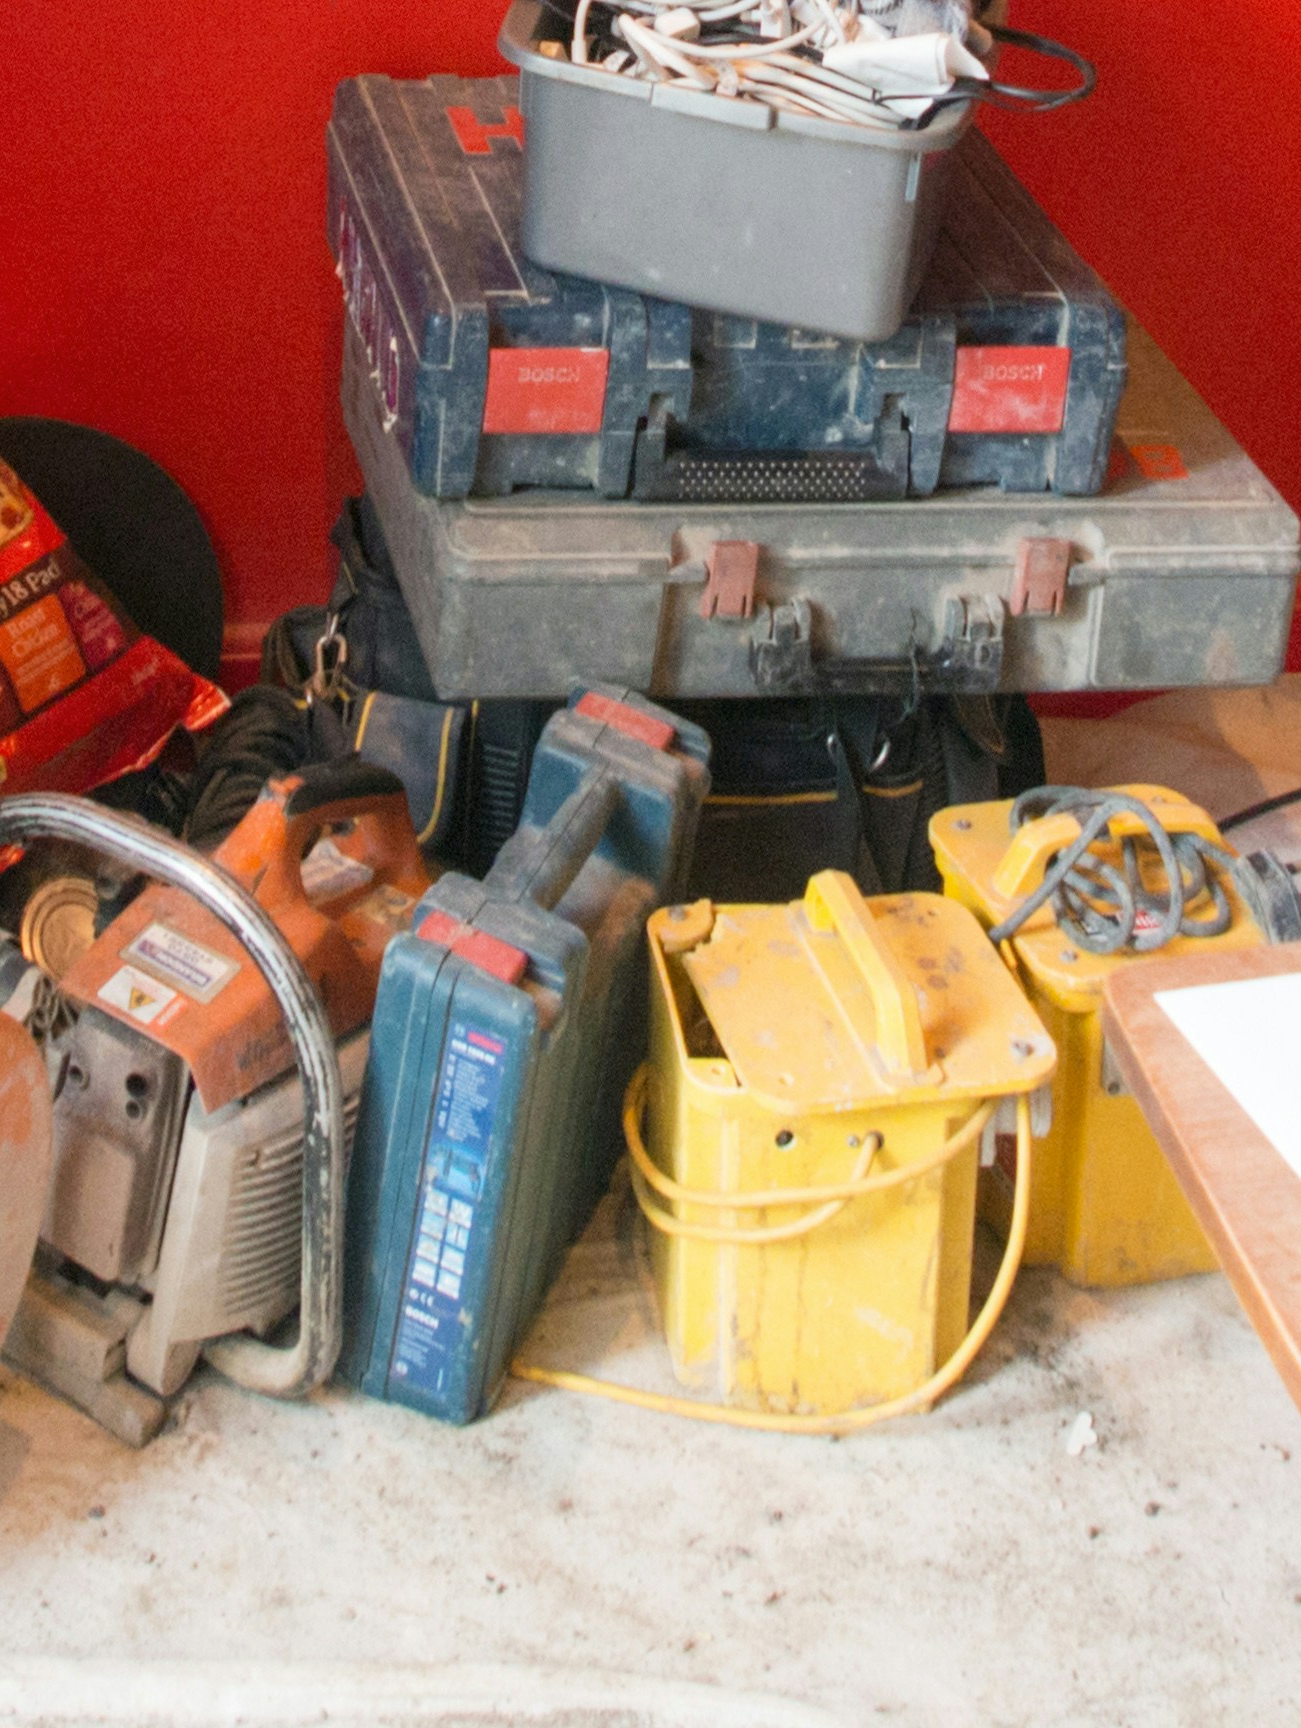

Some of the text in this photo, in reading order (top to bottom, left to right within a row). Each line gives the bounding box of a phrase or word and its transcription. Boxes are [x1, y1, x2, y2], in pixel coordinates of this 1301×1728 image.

[517, 364, 581, 385] BOSCH
[982, 362, 1045, 383] BOSCH
[3, 579, 29, 609] 18
